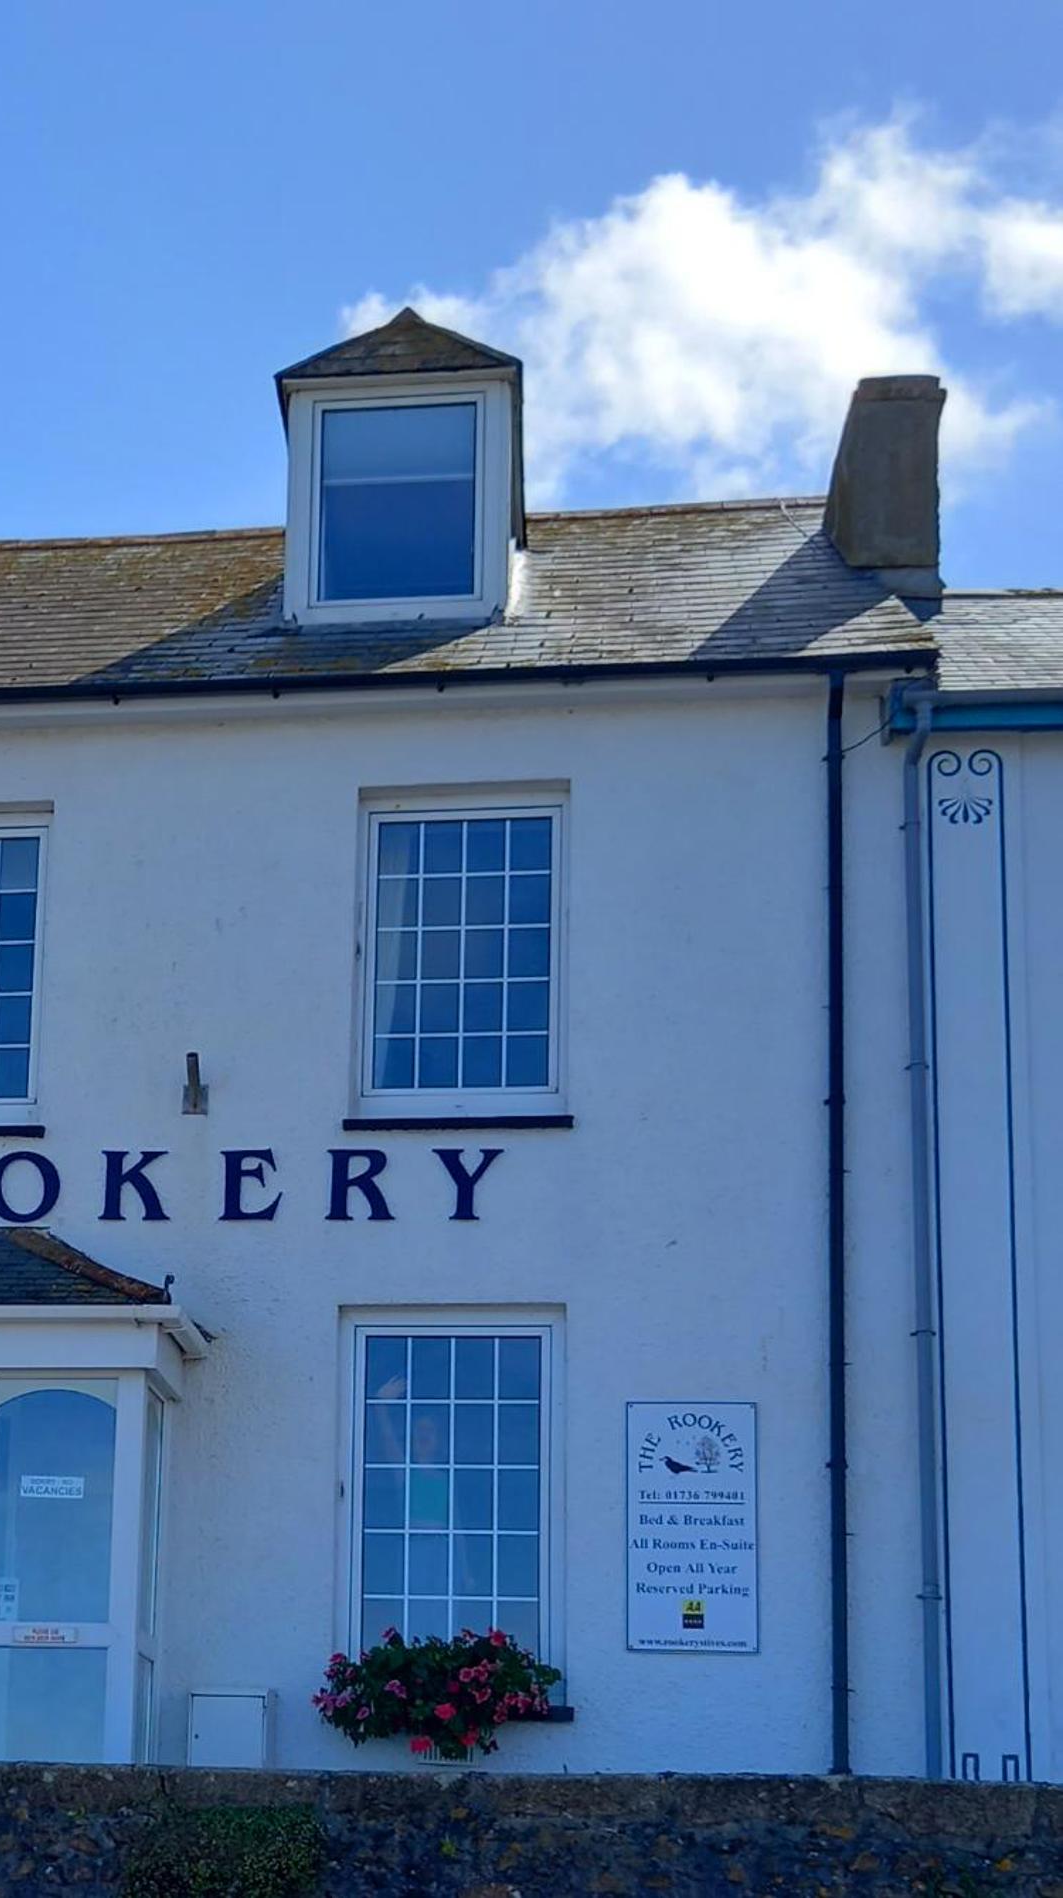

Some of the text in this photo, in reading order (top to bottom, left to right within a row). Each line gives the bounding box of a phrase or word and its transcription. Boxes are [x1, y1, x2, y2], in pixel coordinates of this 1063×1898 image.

[638, 1412, 744, 1473] THE ROOKERY
[21, 1485, 82, 1497] VACANCIES
[665, 1489, 699, 1500] 01736
[639, 1514, 745, 1526] Bed & Breakfast
[629, 1538, 756, 1551] All Rooms En-Suite
[646, 1562, 738, 1576] Open All Year
[636, 1582, 750, 1597] Reserved Parking
[685, 1601, 702, 1612] AA
